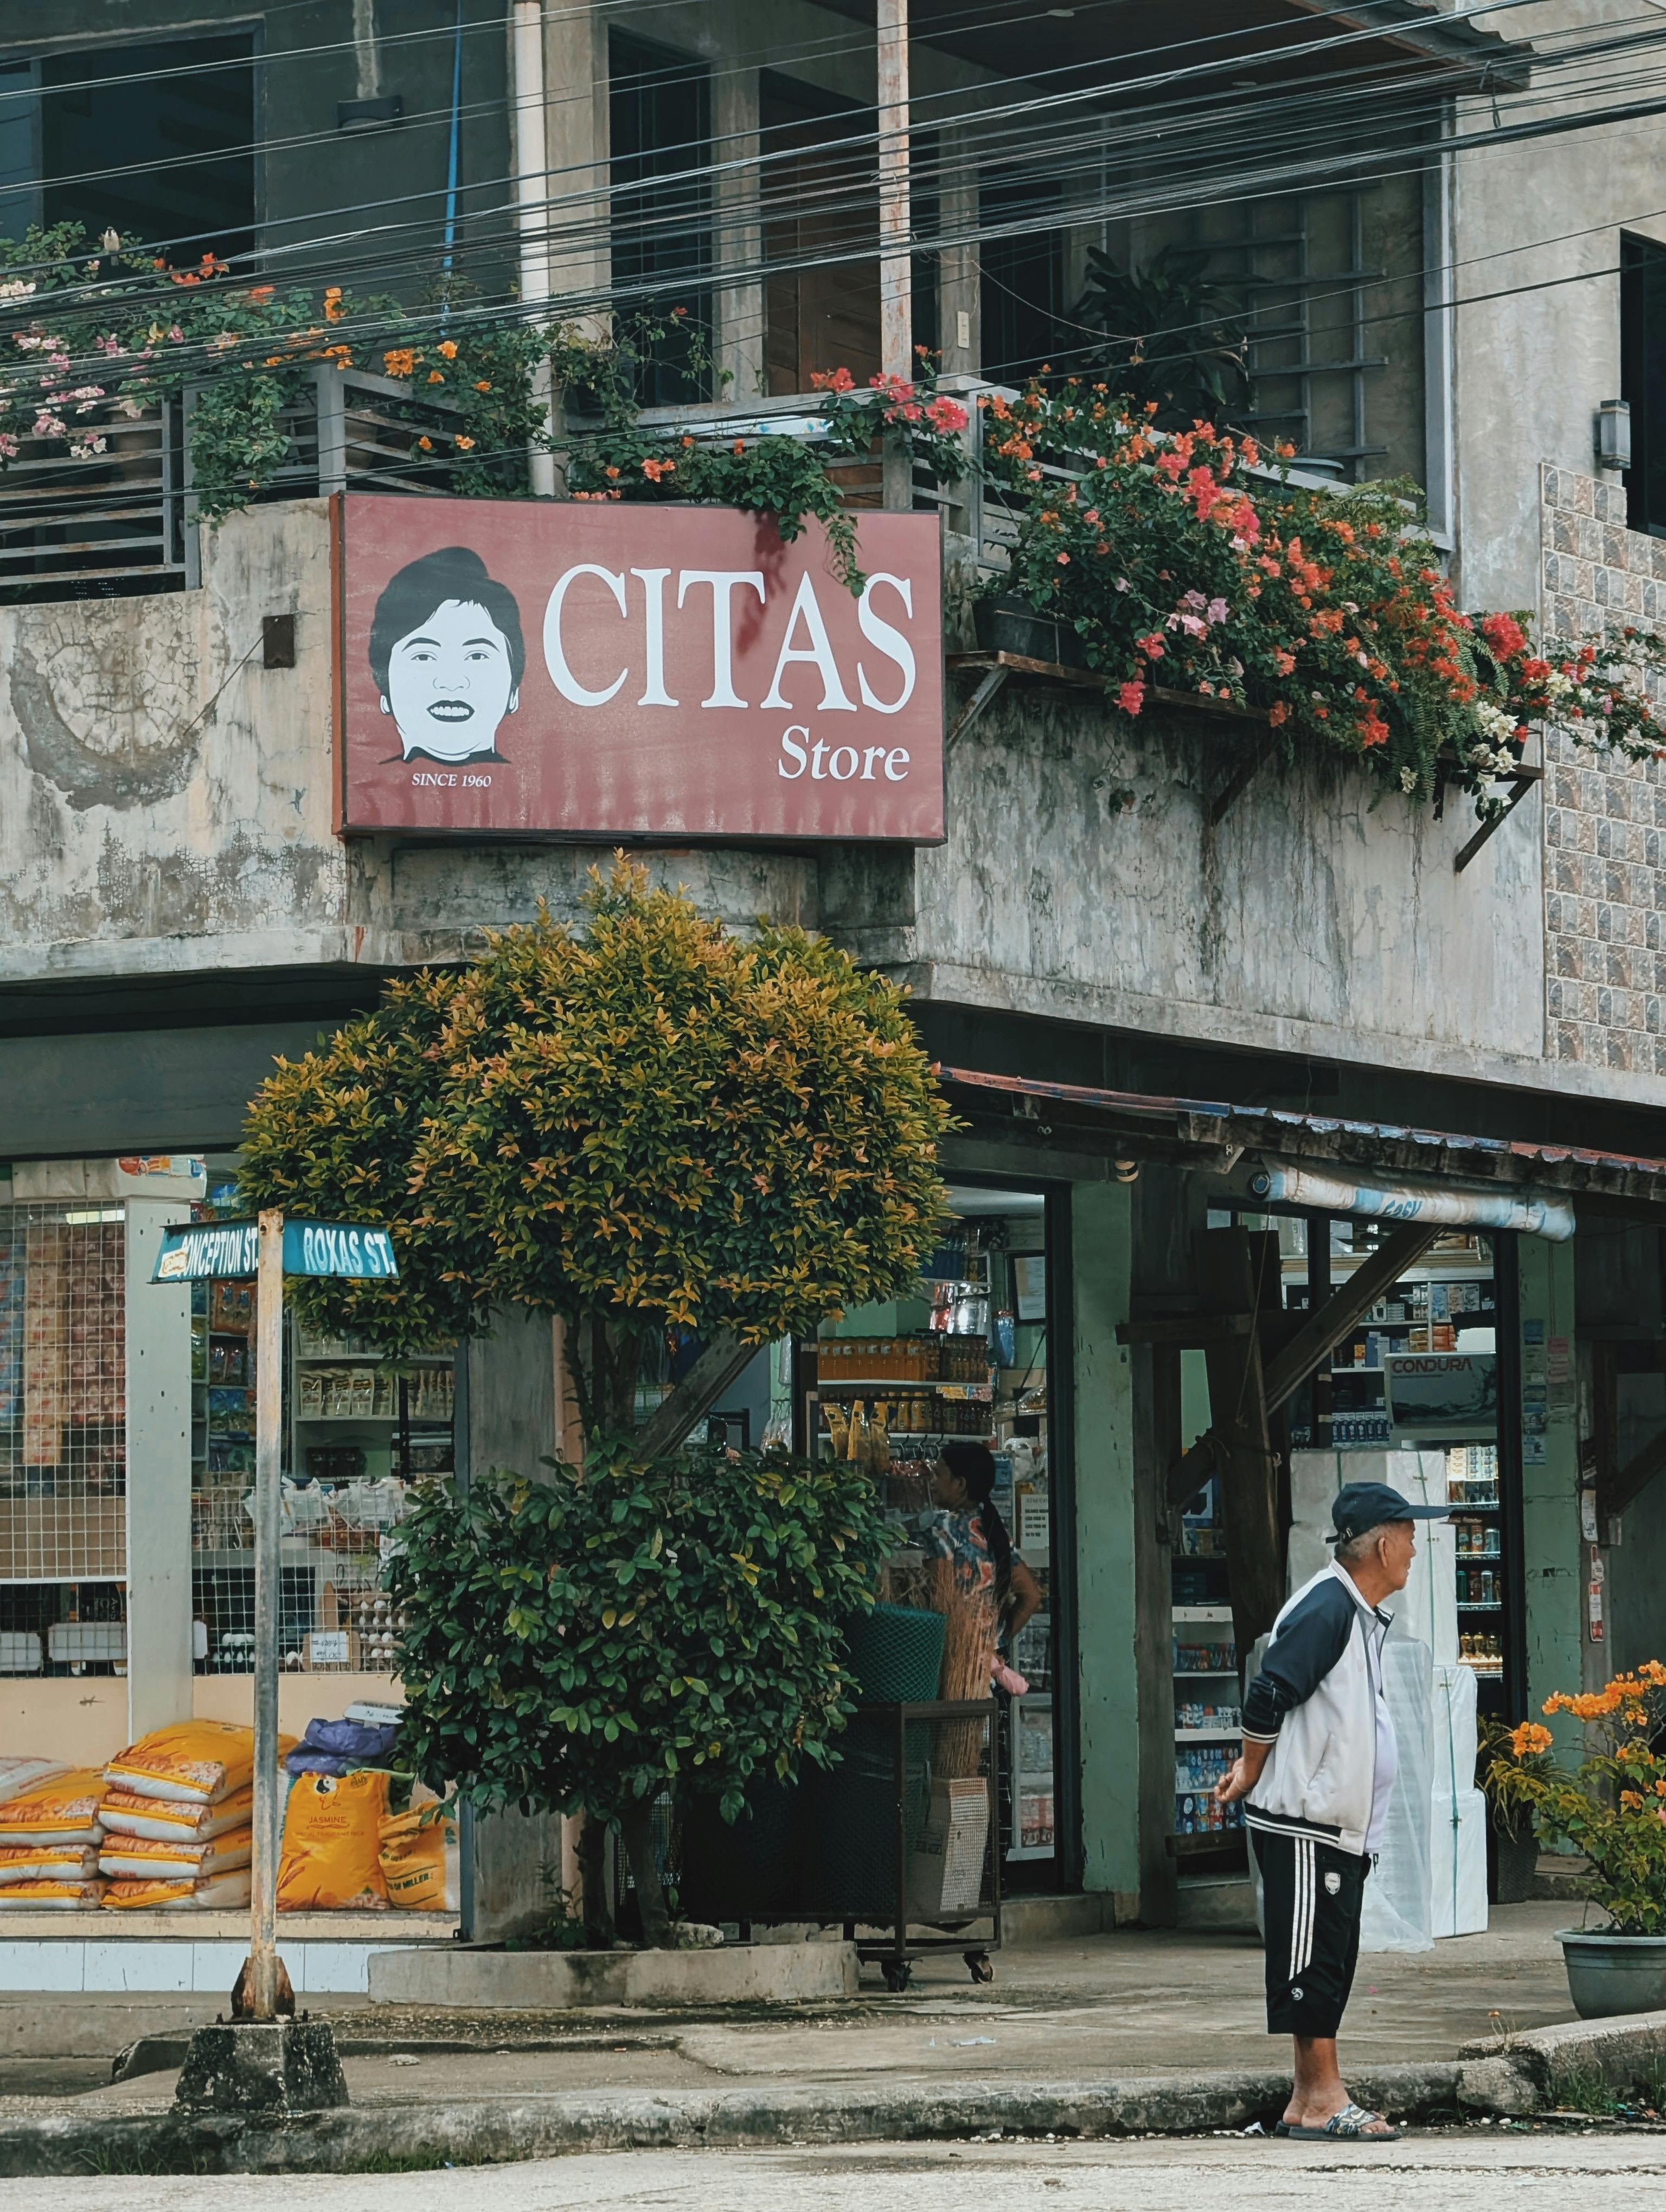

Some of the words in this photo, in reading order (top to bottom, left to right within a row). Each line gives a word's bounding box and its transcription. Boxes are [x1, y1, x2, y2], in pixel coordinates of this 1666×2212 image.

[543, 563, 917, 714] CITAS
[778, 725, 910, 781] Store
[412, 773, 457, 787] SINCE
[462, 774, 491, 788] 1960
[244, 1227, 259, 1272] ST.
[304, 1227, 363, 1274] ROXAS
[364, 1232, 395, 1275] ST.
[1393, 1358, 1473, 1373] CONDURA
